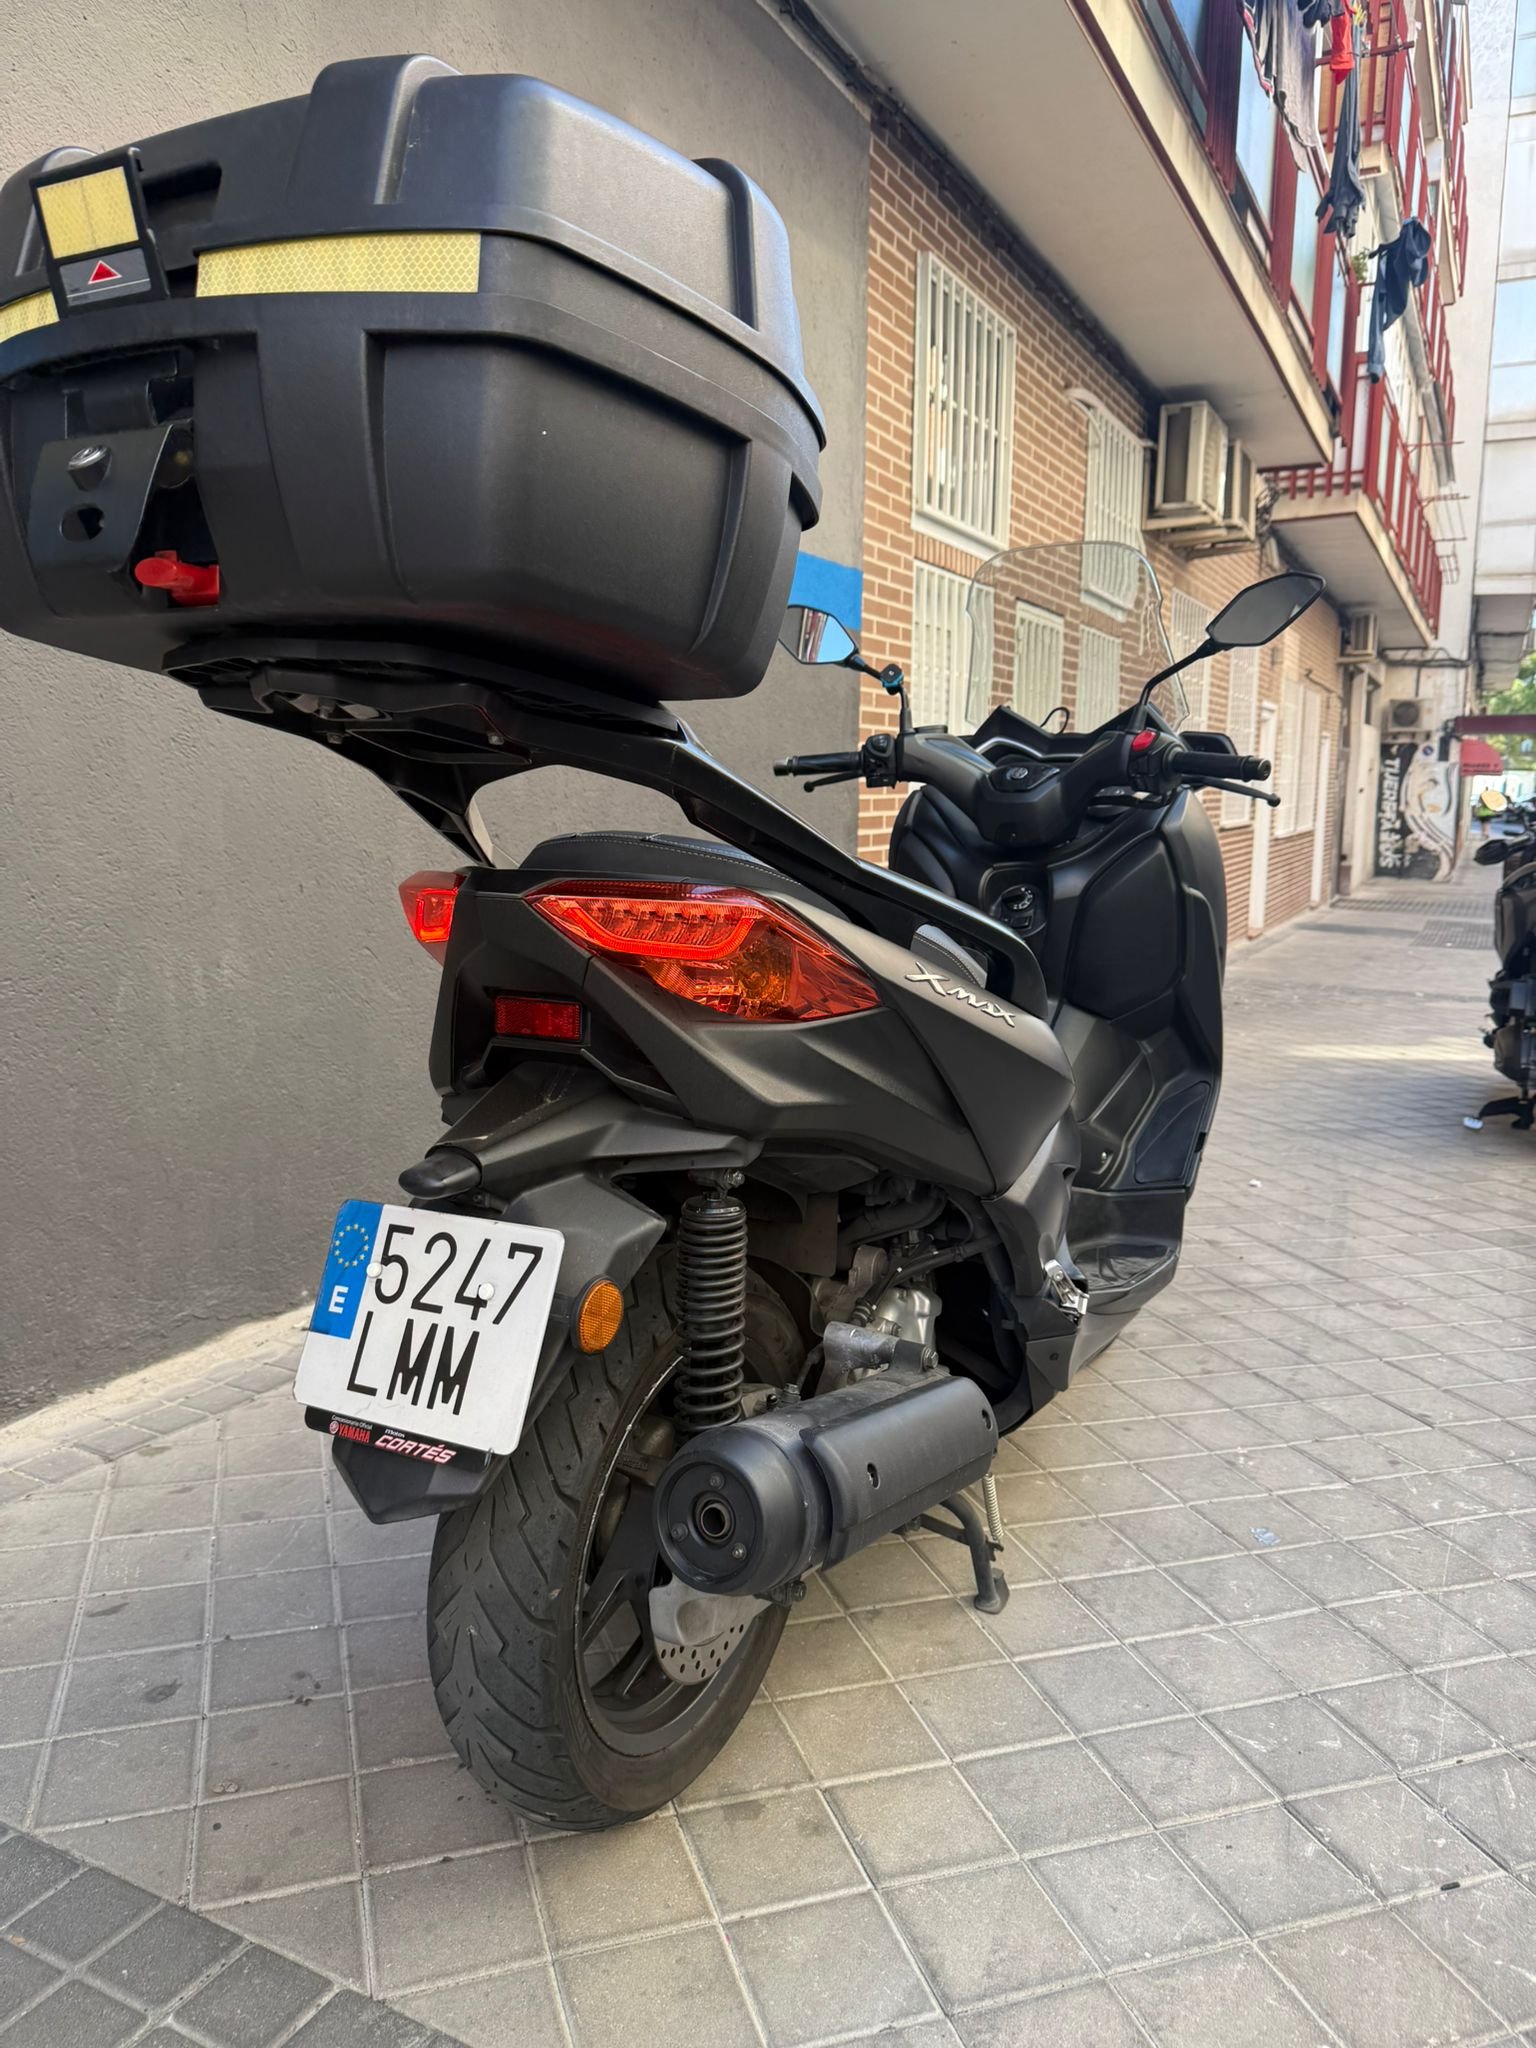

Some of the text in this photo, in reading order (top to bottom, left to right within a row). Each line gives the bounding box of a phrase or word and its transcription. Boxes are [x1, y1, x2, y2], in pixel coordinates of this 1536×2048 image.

[374, 1223, 543, 1325] 5247
[328, 1285, 349, 1314] E
[347, 1310, 480, 1416] LMM
[338, 1423, 371, 1443] YAMAHA
[374, 1435, 457, 1464] CORTÉS
